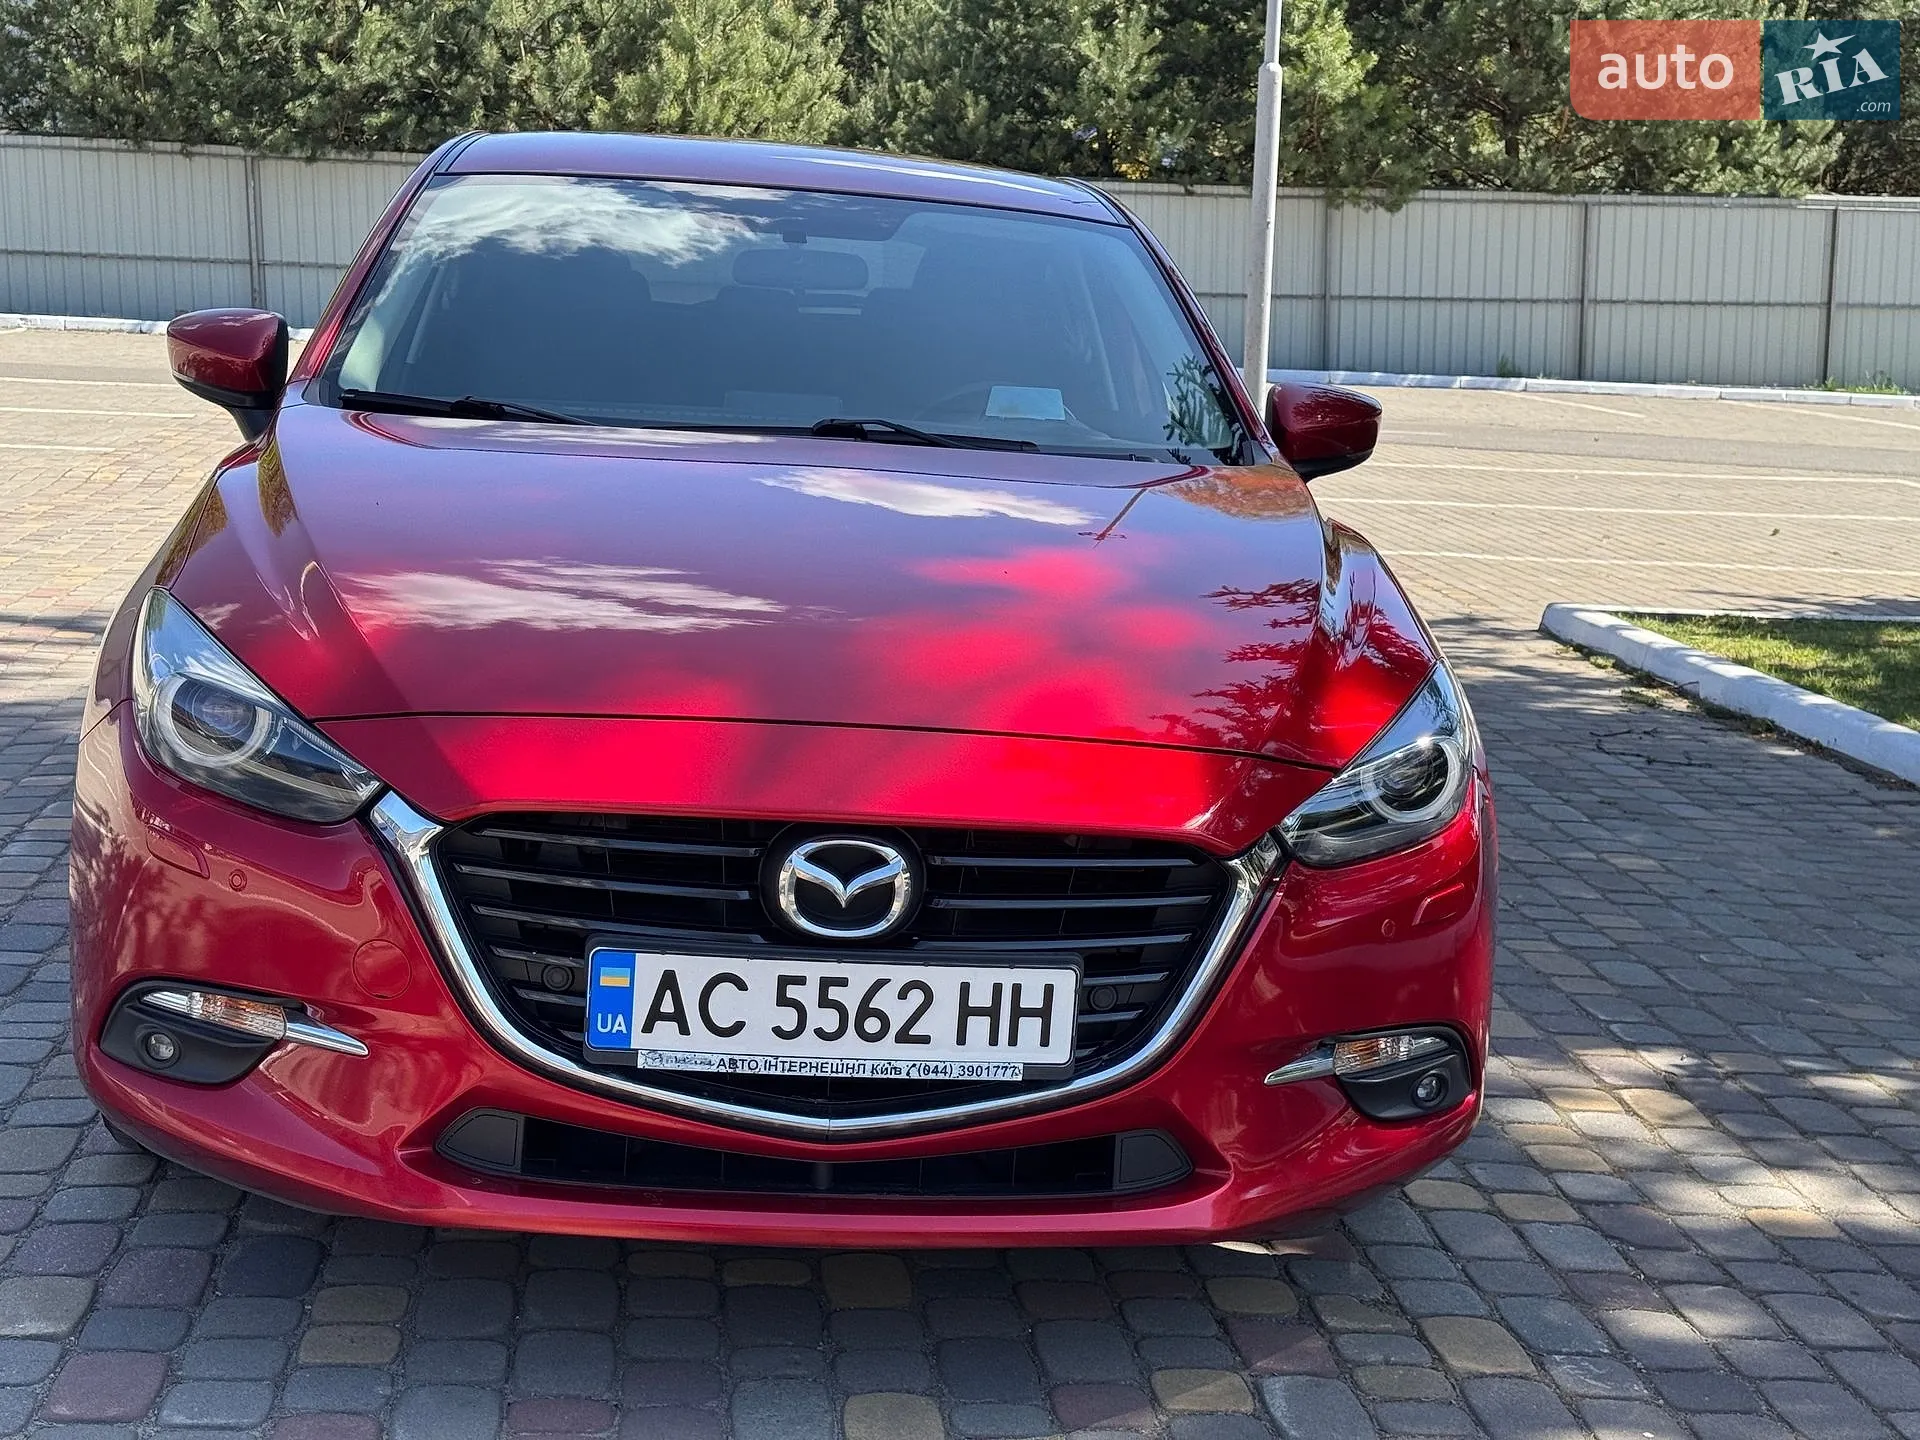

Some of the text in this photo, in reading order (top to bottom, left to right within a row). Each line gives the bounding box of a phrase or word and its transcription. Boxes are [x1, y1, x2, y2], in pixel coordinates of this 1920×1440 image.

[597, 1014, 628, 1034] UA
[640, 969, 1055, 1048] AC 5562 HH
